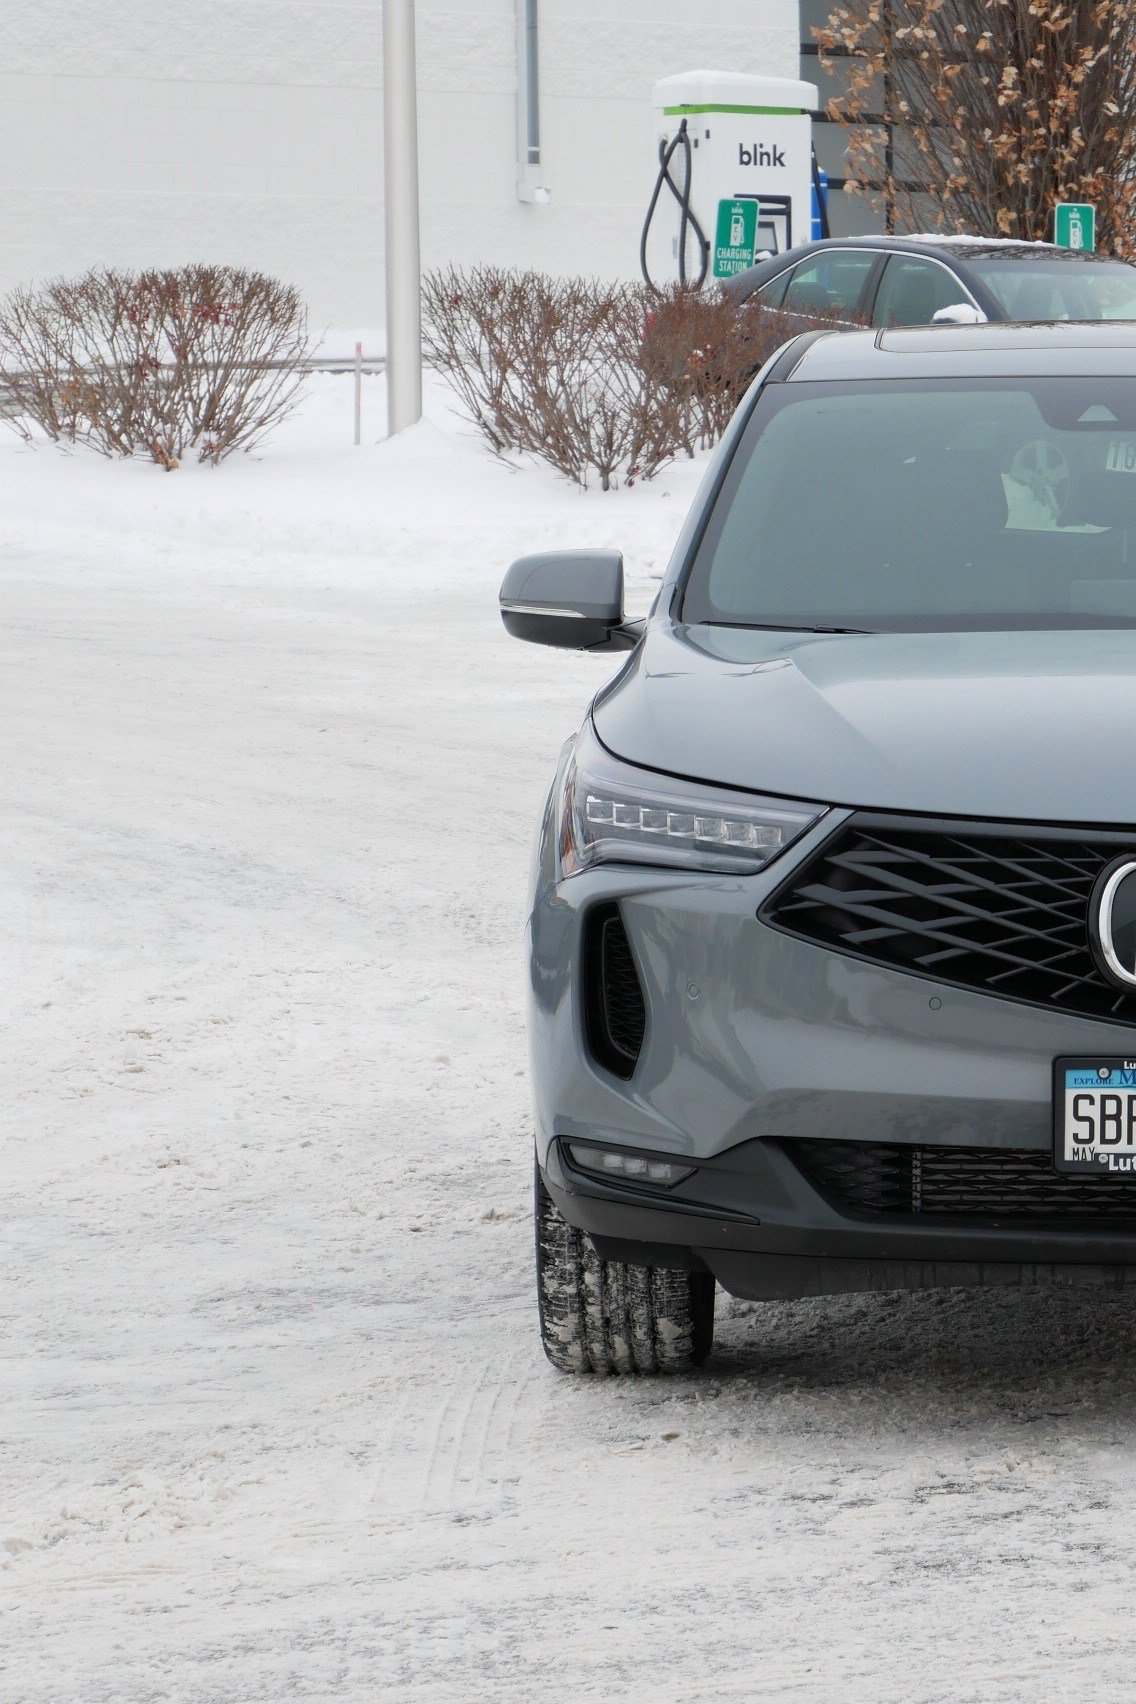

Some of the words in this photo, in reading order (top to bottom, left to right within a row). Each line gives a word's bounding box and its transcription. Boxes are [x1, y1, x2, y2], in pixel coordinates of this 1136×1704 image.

[739, 142, 786, 167] blink
[716, 247, 752, 259] CHARGING
[719, 260, 748, 272] STATION
[1073, 1077, 1114, 1085] EXPLORE
[1072, 1147, 1096, 1162] MAY
